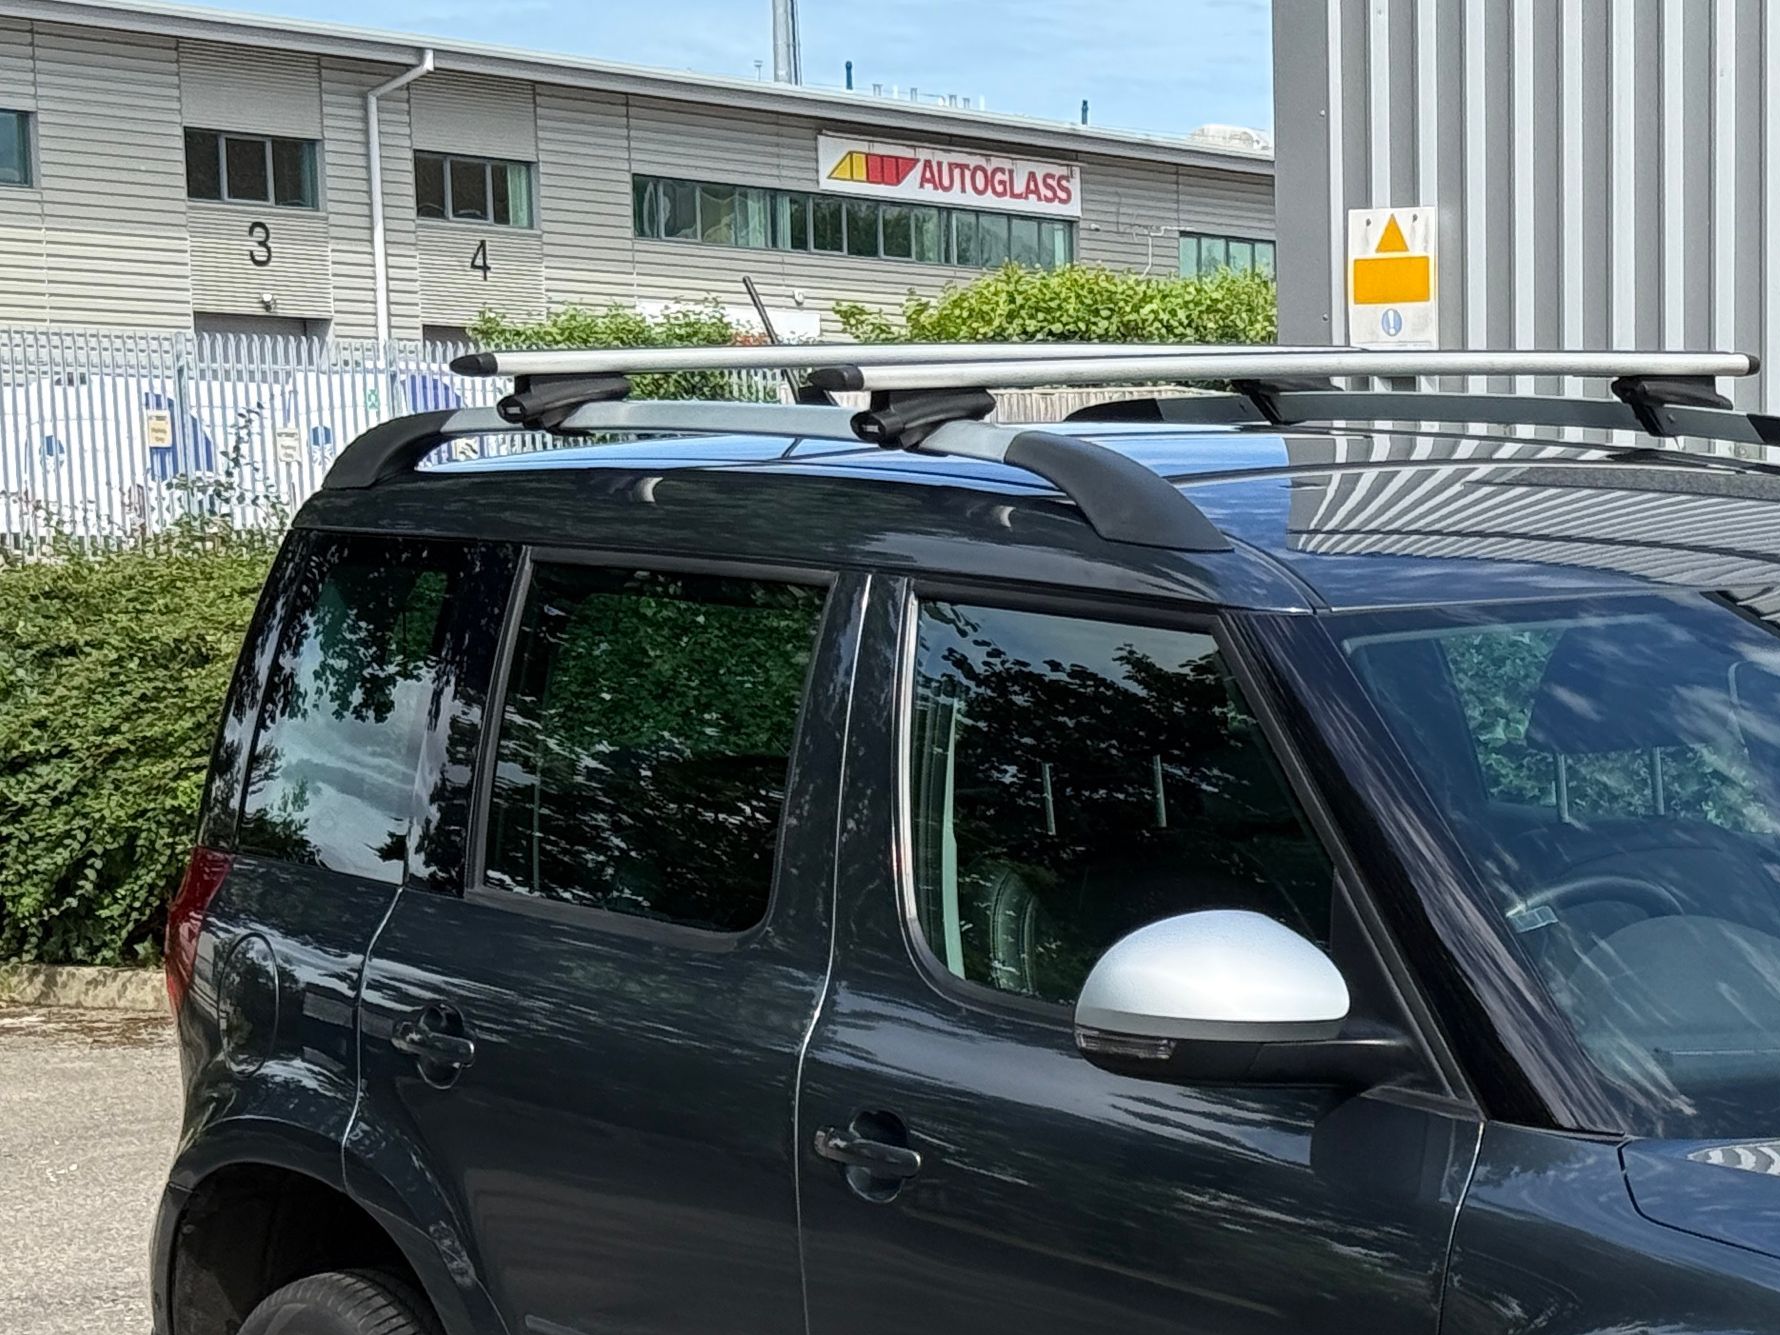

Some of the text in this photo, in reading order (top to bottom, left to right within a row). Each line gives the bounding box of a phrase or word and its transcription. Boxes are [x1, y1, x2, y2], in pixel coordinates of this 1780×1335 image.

[919, 159, 1072, 205] AUTOGLASS
[248, 221, 272, 267] 3
[470, 239, 491, 281] 4
